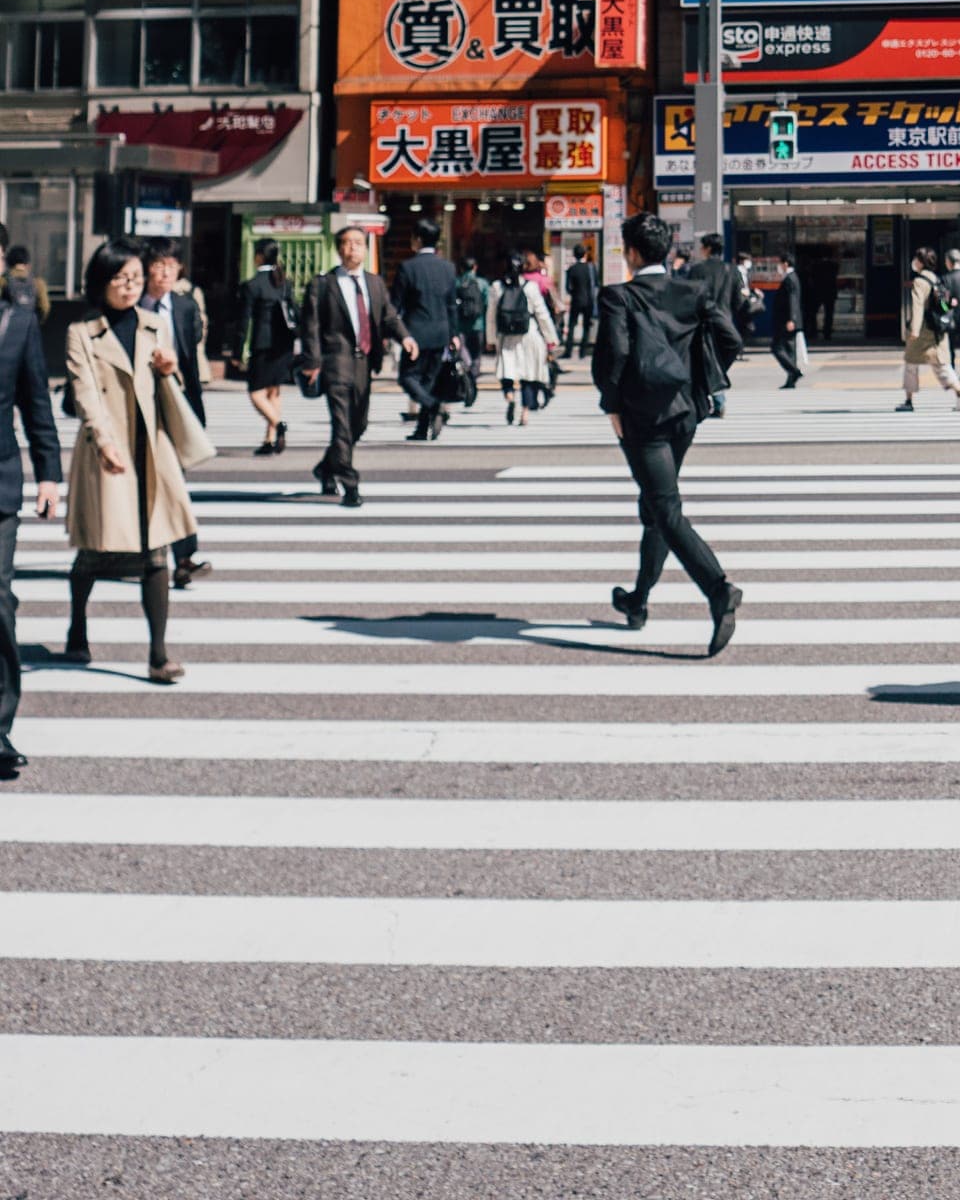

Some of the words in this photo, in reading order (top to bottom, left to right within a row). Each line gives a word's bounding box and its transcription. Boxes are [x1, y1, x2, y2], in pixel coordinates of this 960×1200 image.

[723, 26, 758, 45] sto
[765, 42, 831, 57] express
[452, 105, 526, 122] EXCHANGE
[378, 126, 527, 176] 大黒屋
[852, 153, 919, 170] ACCESS
